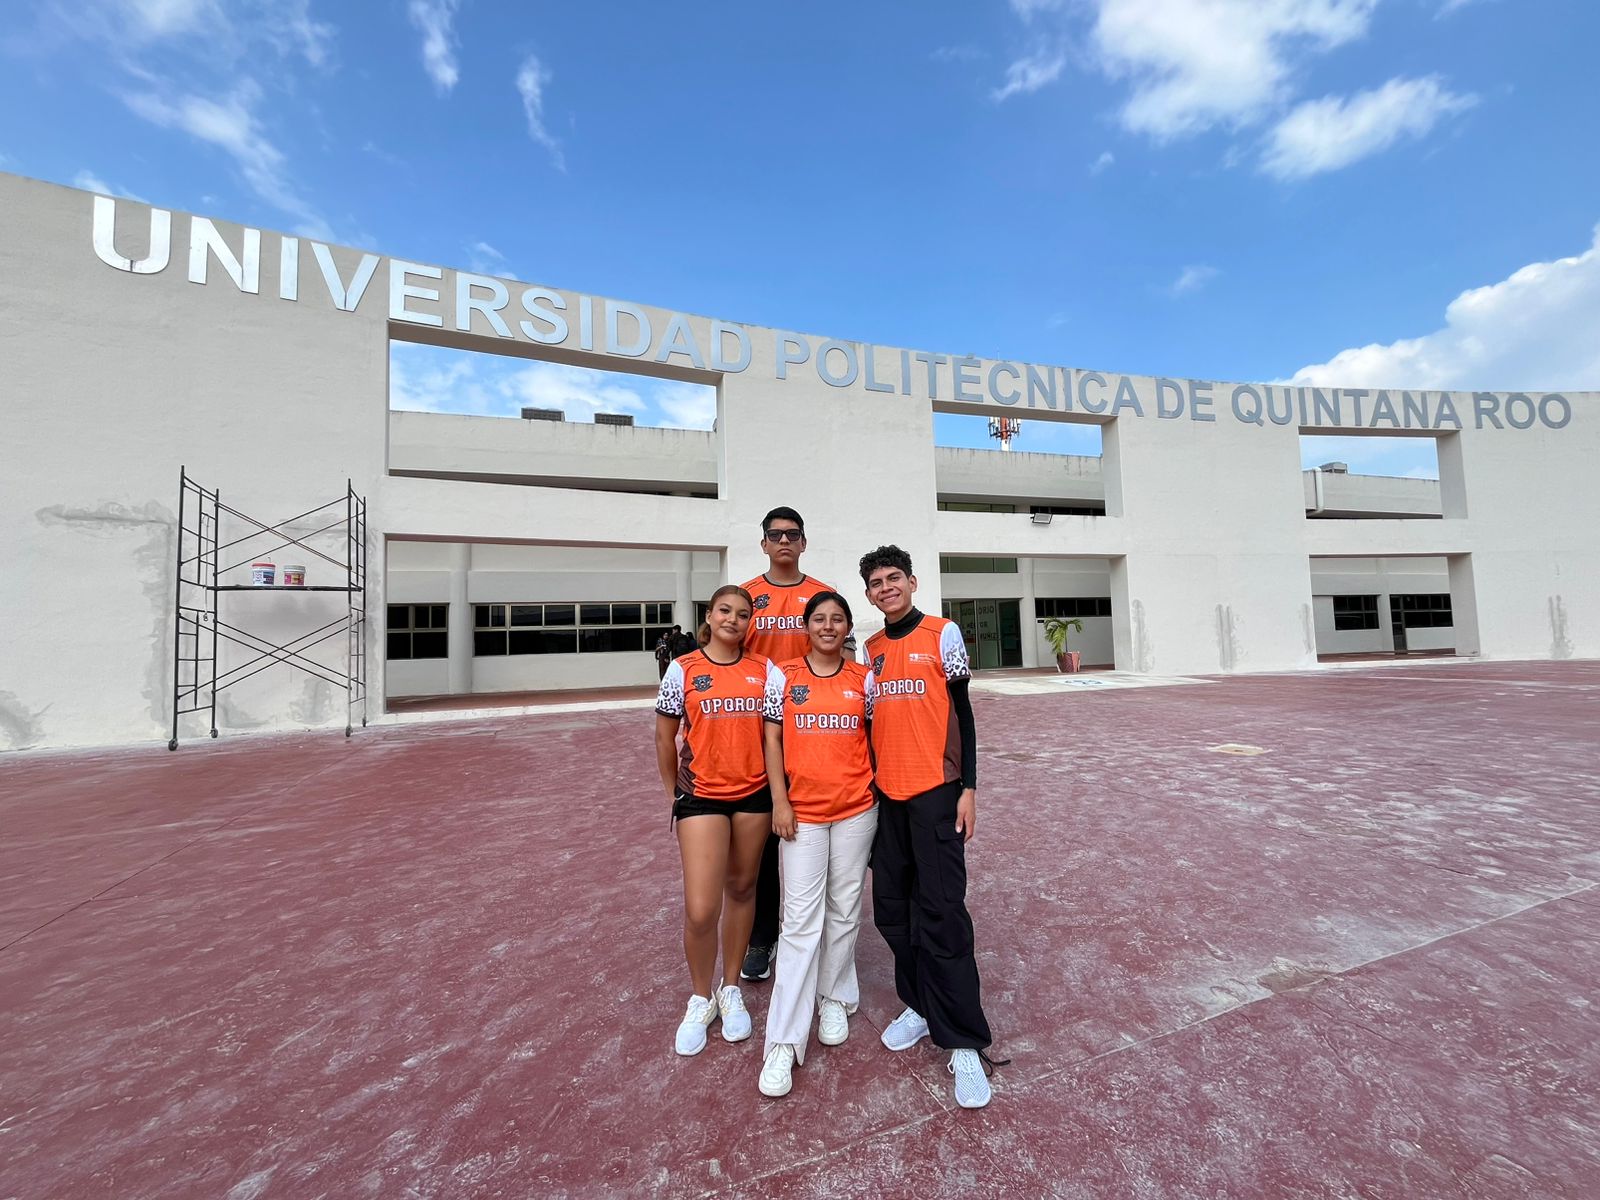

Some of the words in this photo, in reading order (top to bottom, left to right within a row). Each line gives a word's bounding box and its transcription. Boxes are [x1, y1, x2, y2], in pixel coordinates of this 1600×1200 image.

[93, 195, 752, 373] UNIVERSIDAD
[775, 332, 1144, 417] POLITÉCNICA
[1156, 376, 1216, 422] DE
[1232, 383, 1463, 429] QUINTANA
[1473, 392, 1573, 431] ROO
[755, 615, 804, 630] UPQRO
[699, 697, 763, 714] UPQROO
[794, 713, 860, 730] UPQROO
